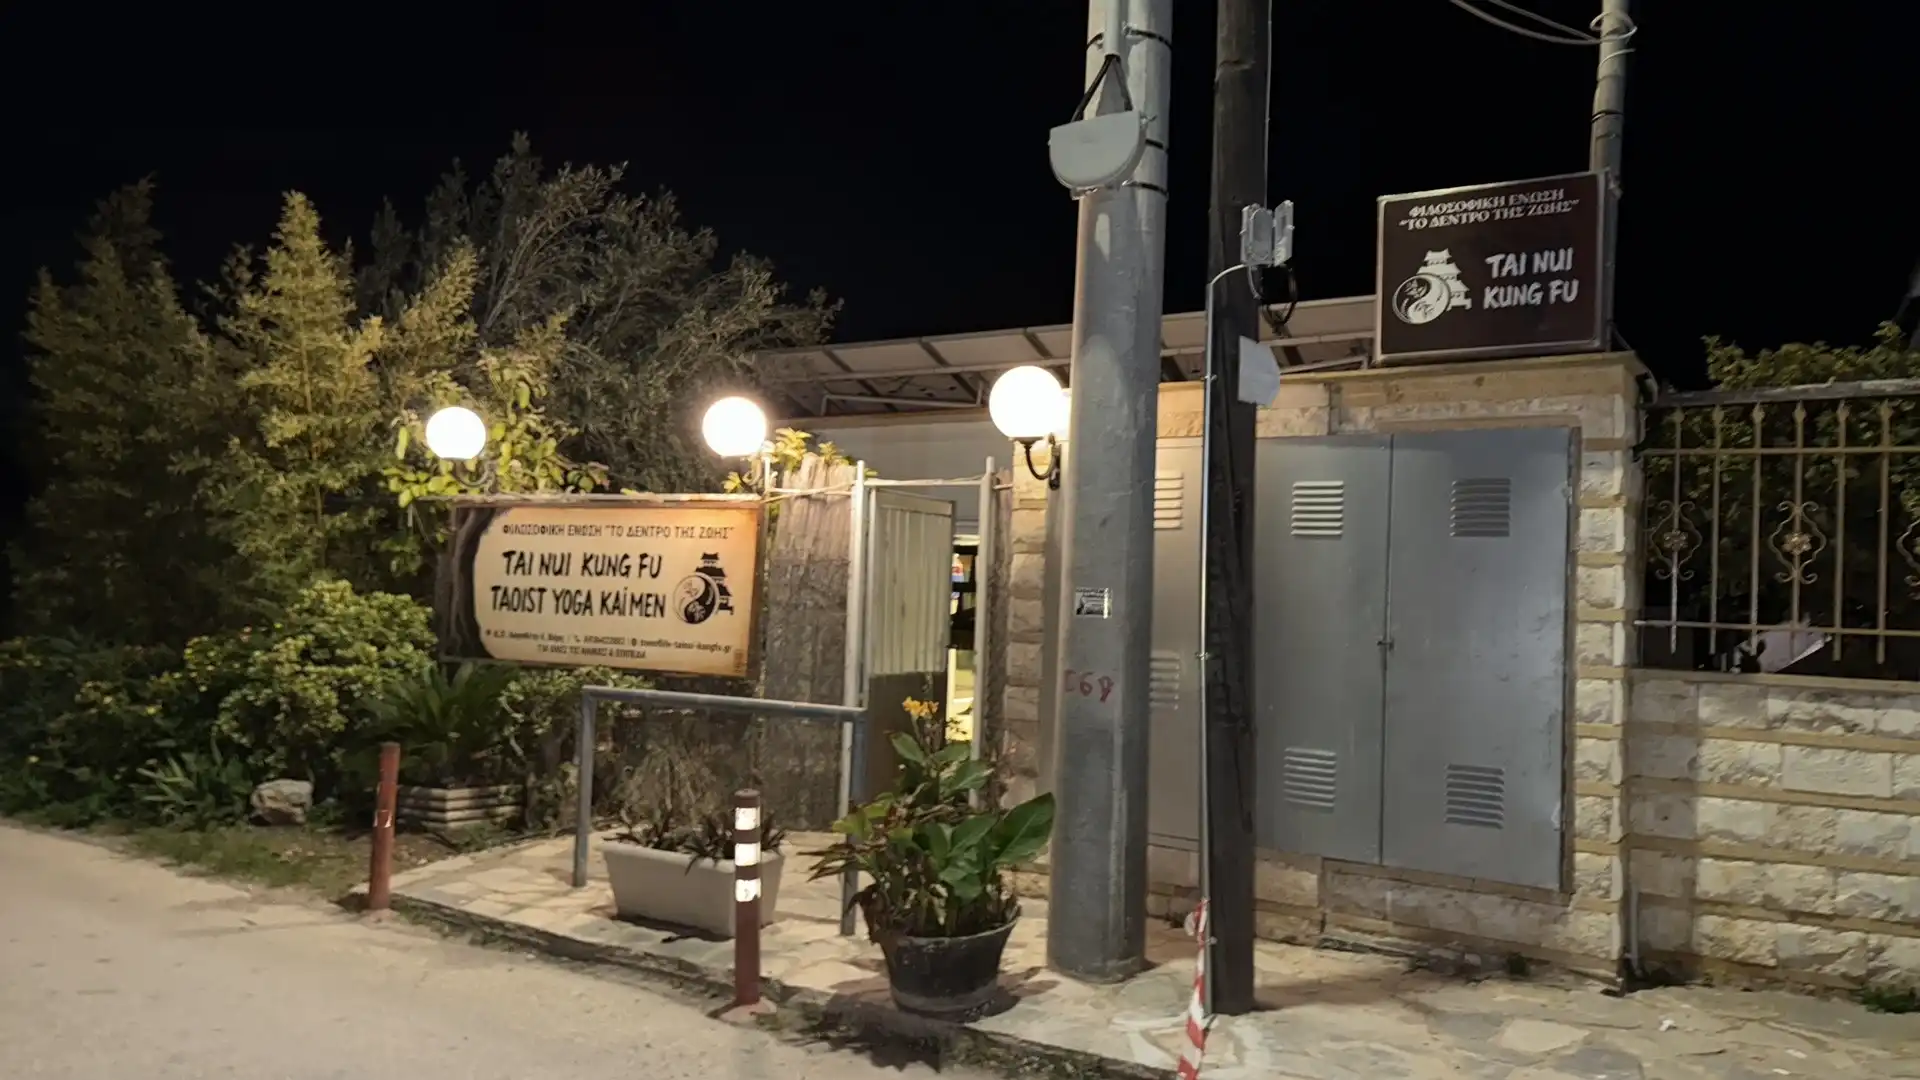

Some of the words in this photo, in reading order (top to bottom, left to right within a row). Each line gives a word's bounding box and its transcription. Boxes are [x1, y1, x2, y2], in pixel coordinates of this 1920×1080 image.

[1408, 195, 1506, 218] ΦΙΛΟΣΟΦΙΚΗ
[1508, 188, 1565, 206] ΕΝΩΣΗ
[1429, 210, 1490, 228] ΔΕΝΤΡΟ
[1493, 205, 1525, 220] ΤΗΣ
[1485, 252, 1527, 279] TAI
[1531, 247, 1573, 275] NUI
[1483, 281, 1544, 310] KUNG
[1547, 278, 1580, 305] FU
[626, 525, 671, 538] ΔΕΝΤΡΟ
[674, 525, 696, 539] ΤΗΣ
[502, 550, 534, 576] TAI
[539, 551, 571, 577] NUI
[580, 551, 631, 578] KUNG
[637, 552, 663, 579] FU
[491, 585, 548, 614] TAOIST
[552, 588, 594, 617] YOGA
